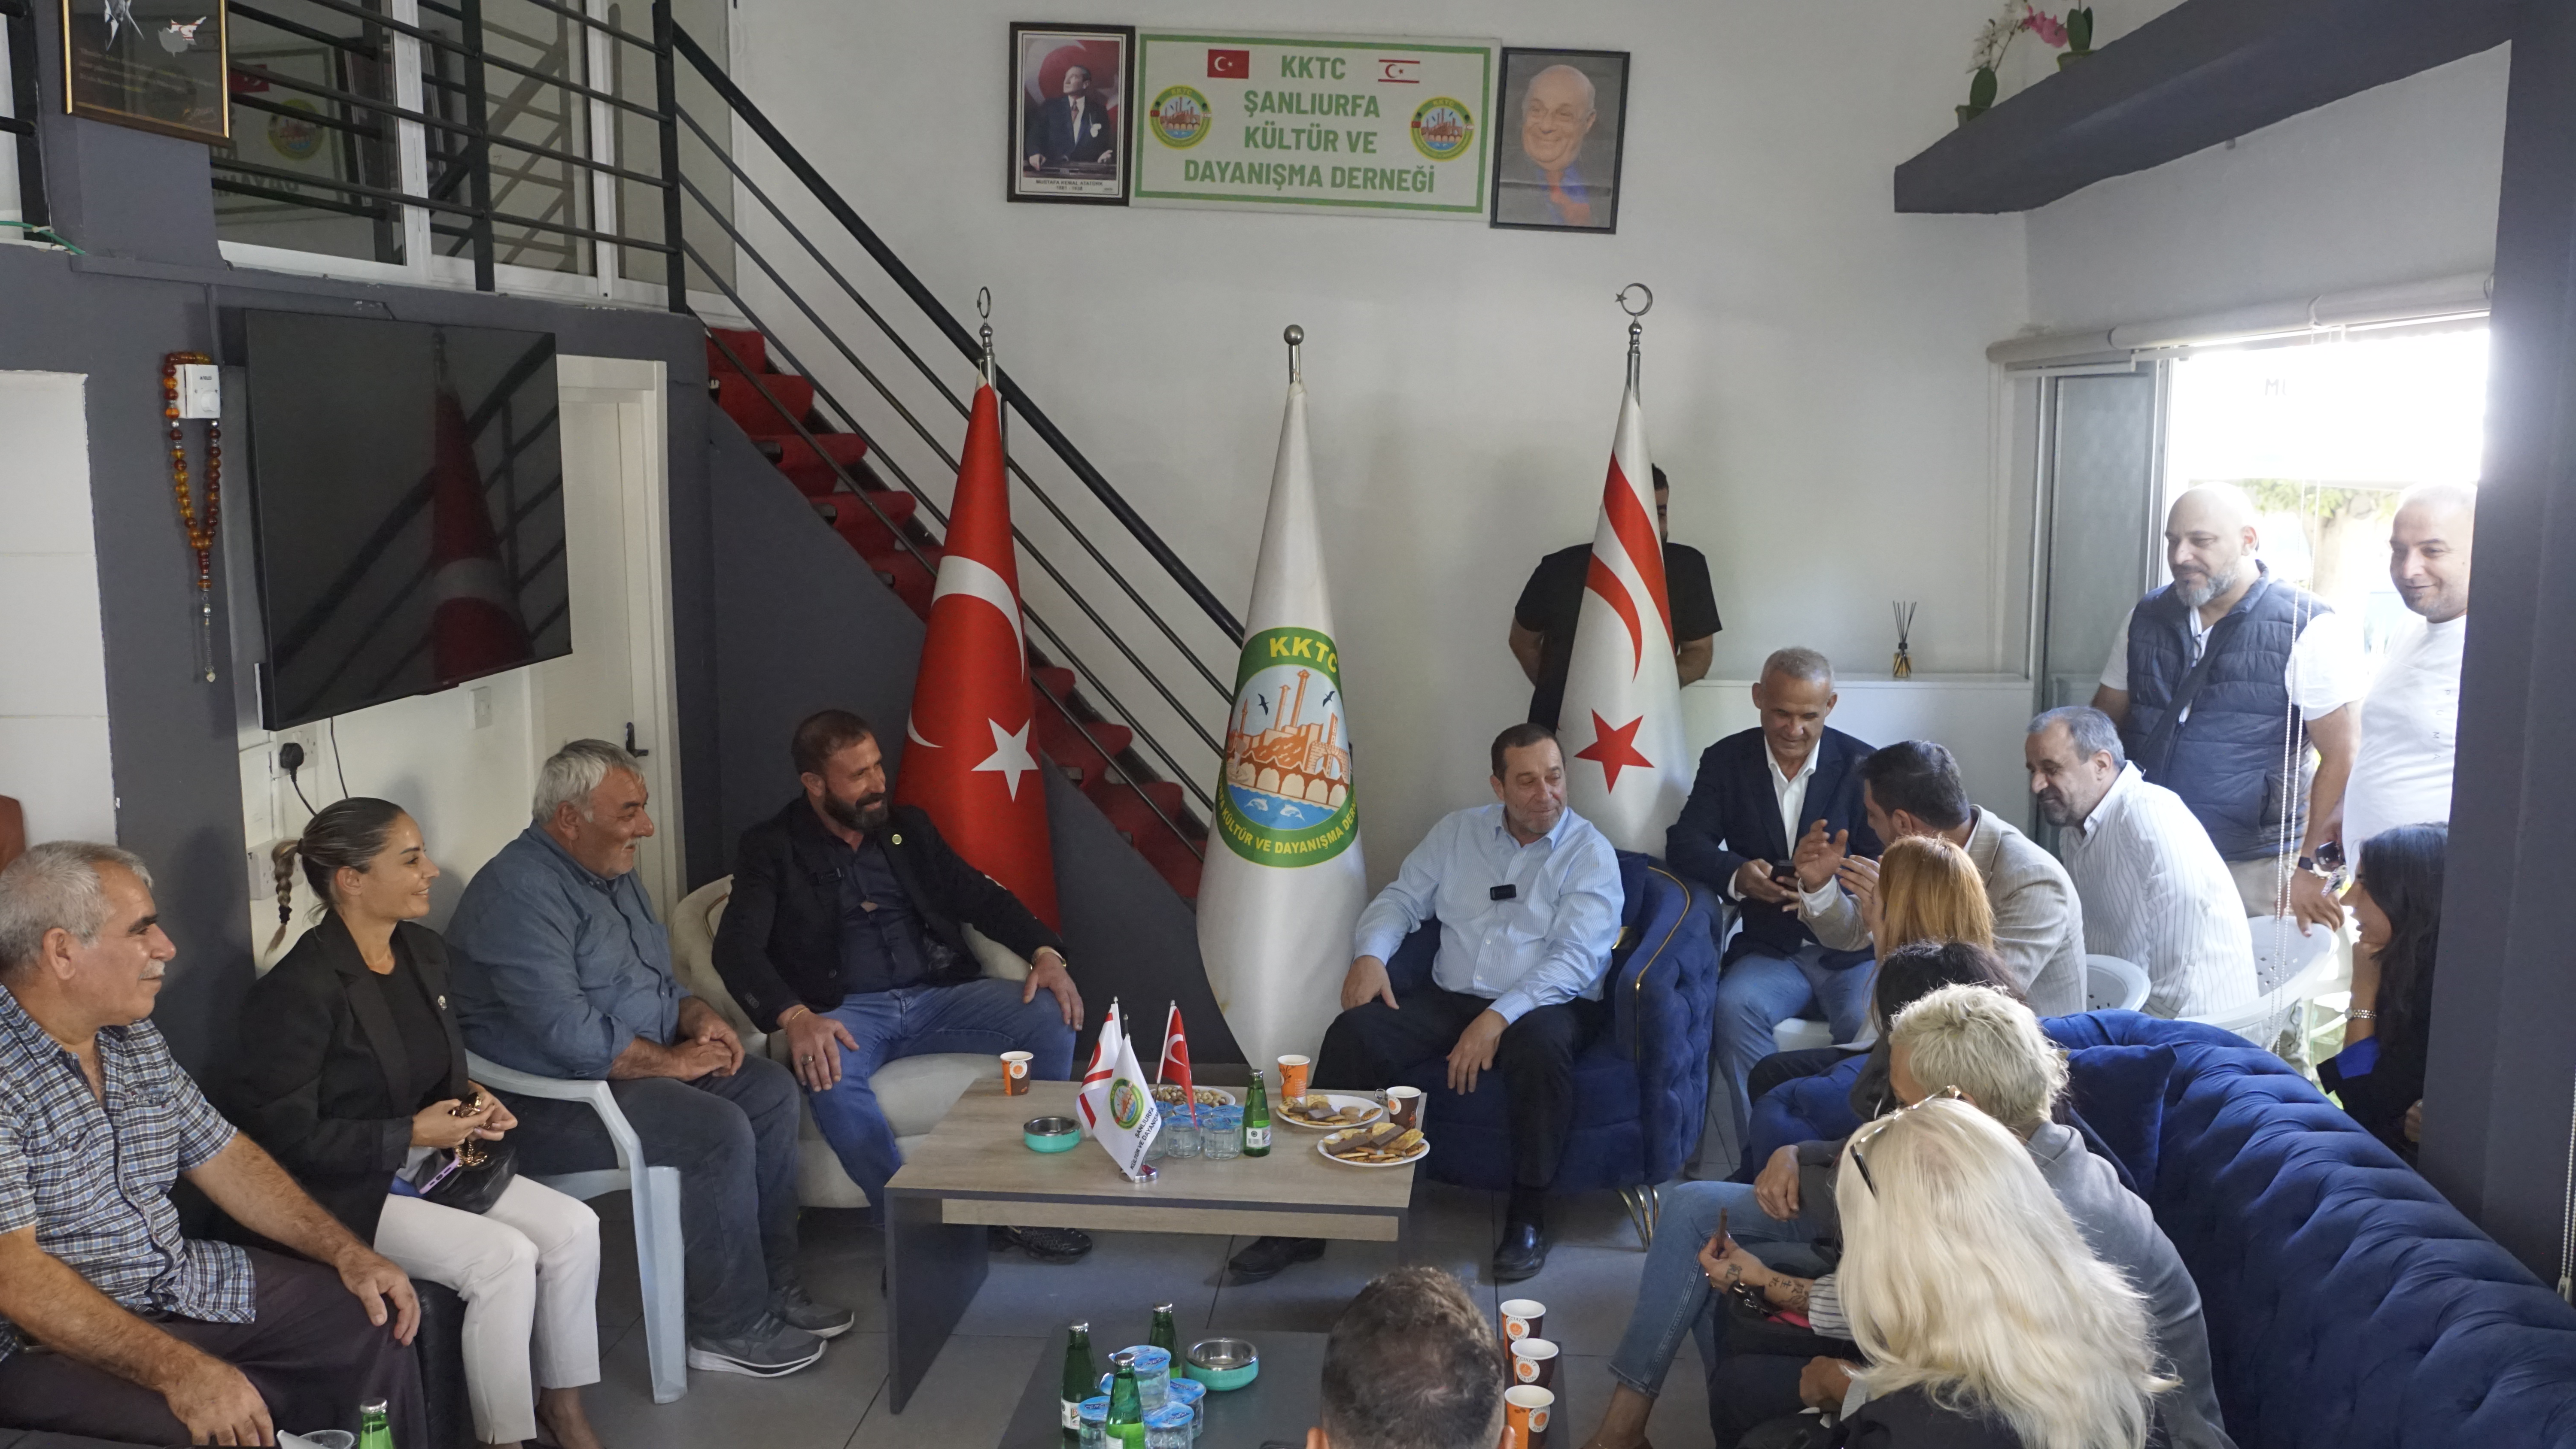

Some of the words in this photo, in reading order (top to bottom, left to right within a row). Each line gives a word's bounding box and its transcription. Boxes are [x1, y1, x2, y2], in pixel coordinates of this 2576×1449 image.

[1281, 55, 1346, 80] KKTC
[1244, 90, 1380, 119] ŞANLIURFA
[1244, 121, 1339, 152] KÜLTÜR
[1346, 130, 1378, 154] VE
[1184, 159, 1323, 191] DAYANIŞMA
[1331, 165, 1435, 193] DERNEĞİ
[1270, 637, 1338, 673] KKTC
[2432, 689, 2451, 759] PUMA
[1222, 807, 1253, 846] KÜLTÜR
[1256, 837, 1271, 852] VE
[1275, 826, 1344, 854] DAYANIŞMA
[1135, 1107, 1155, 1138] ŞANLIURFA
[1130, 1148, 1141, 1170] KÜLTÜR
[1138, 1141, 1145, 1149] VE
